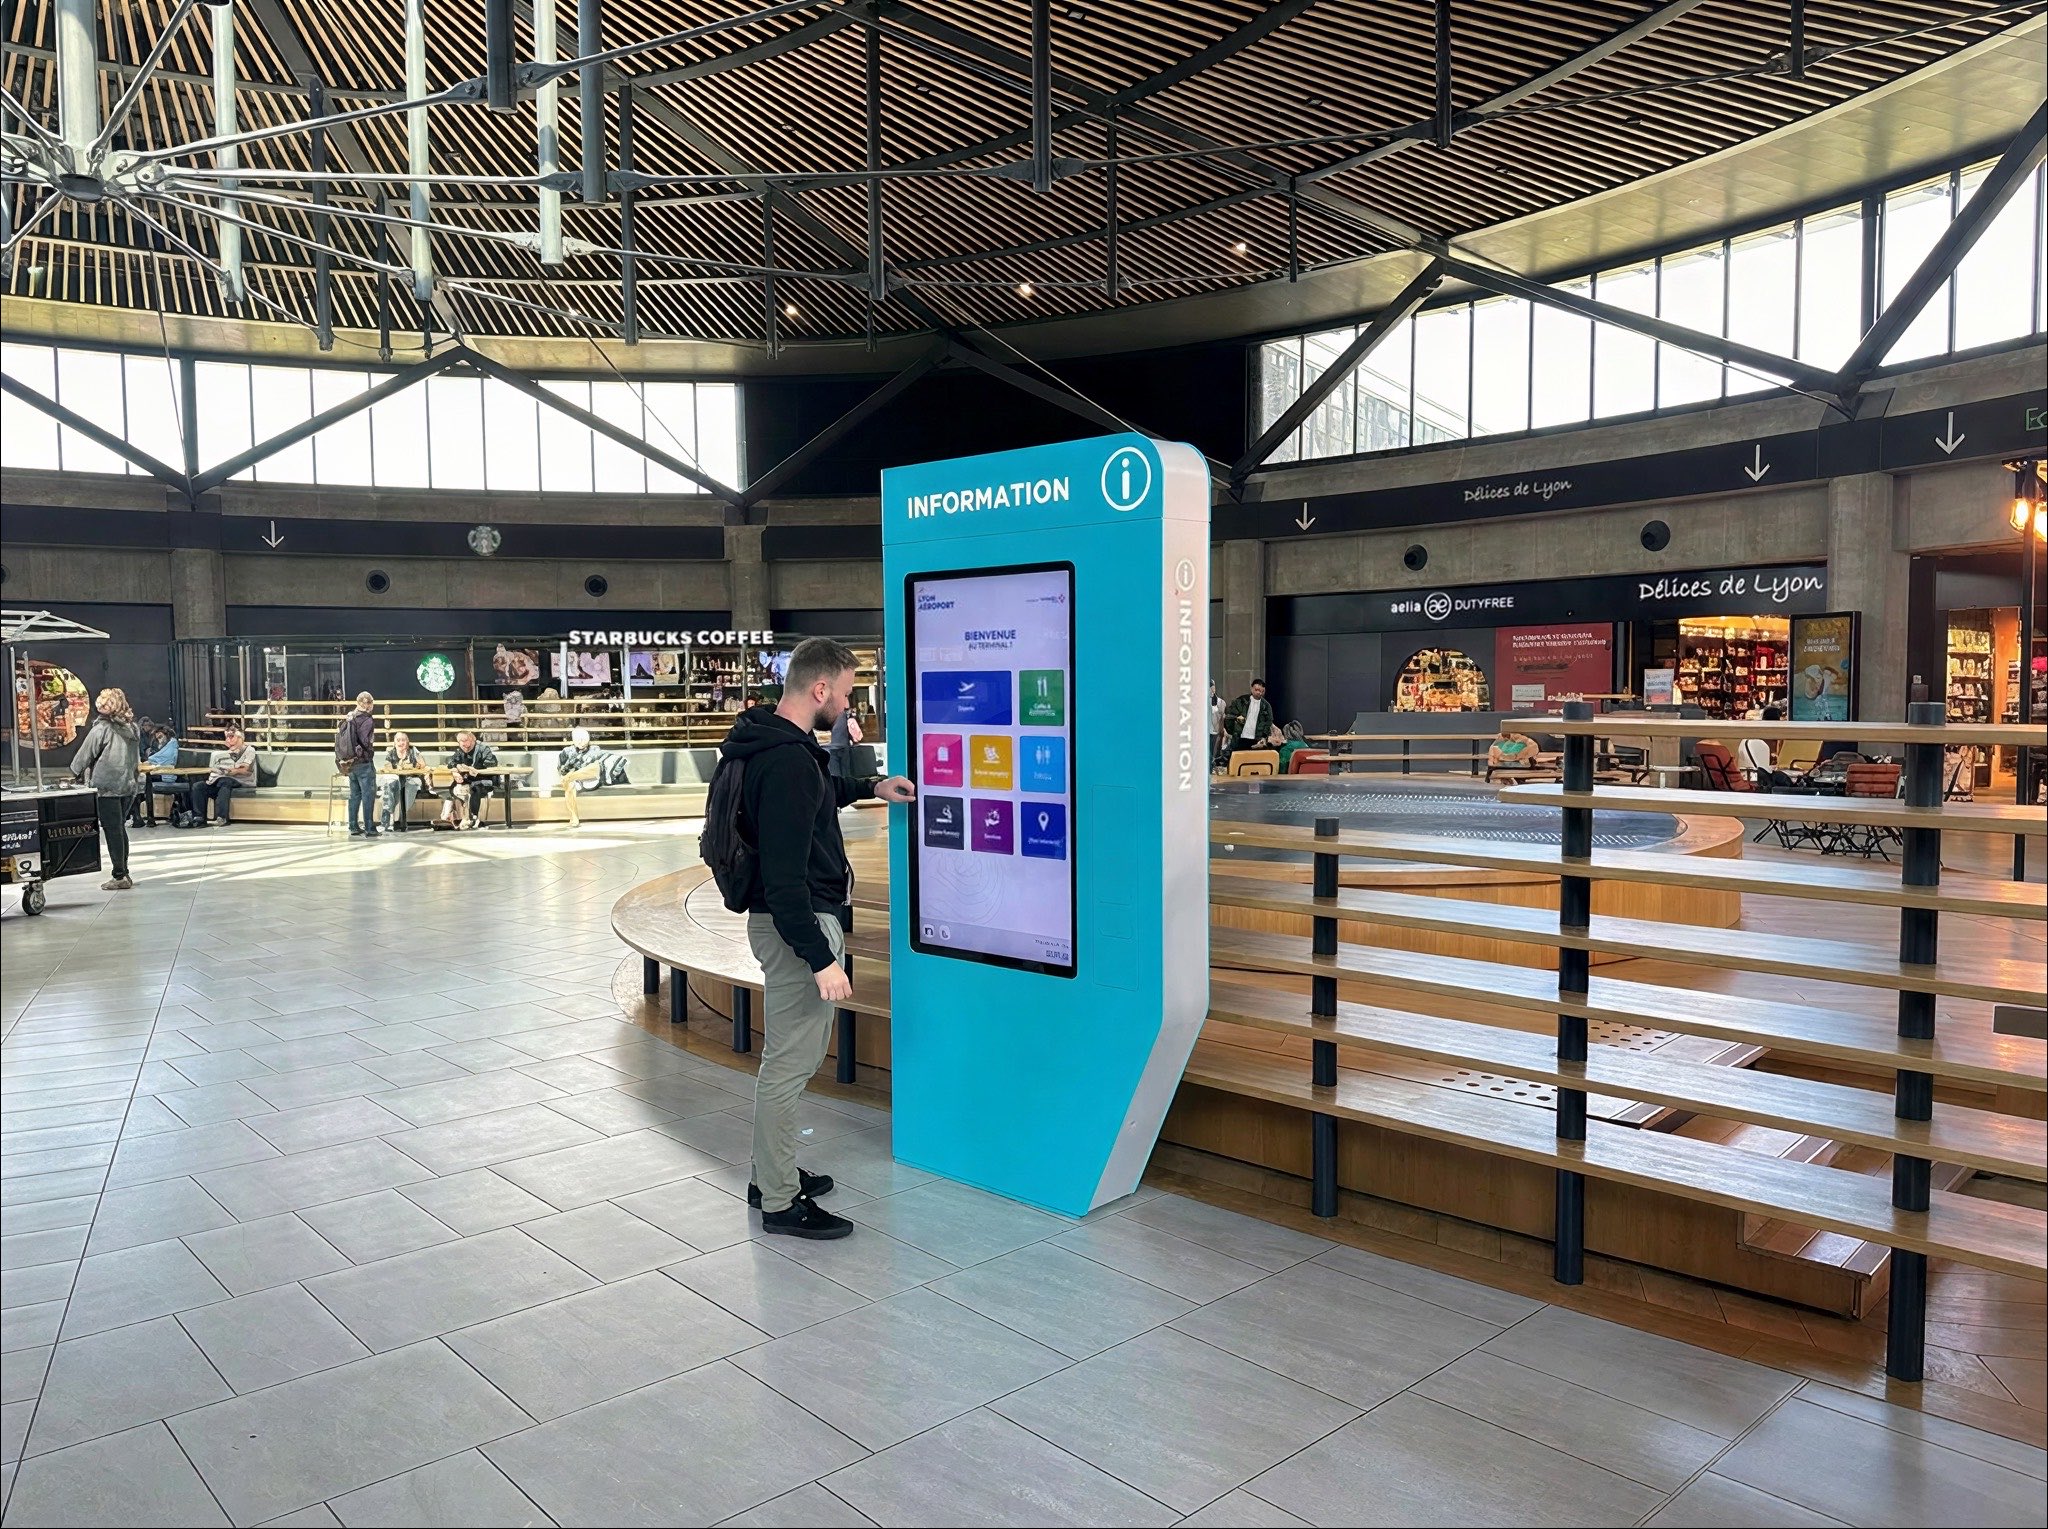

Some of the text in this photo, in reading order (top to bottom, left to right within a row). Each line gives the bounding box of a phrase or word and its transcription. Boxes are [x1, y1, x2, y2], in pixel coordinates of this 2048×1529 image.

[907, 476, 1070, 519] INFORMATION
[1464, 480, 1572, 503] Délices de Lyon
[1638, 574, 1823, 603] Délices de Lyon
[1390, 601, 1421, 614] aelia
[1454, 597, 1515, 611] DUTYFREE
[568, 630, 774, 645] STARBUCKS COFFEE
[964, 629, 1016, 641] BIENVENUE
[1178, 599, 1192, 791] INFORMATION
